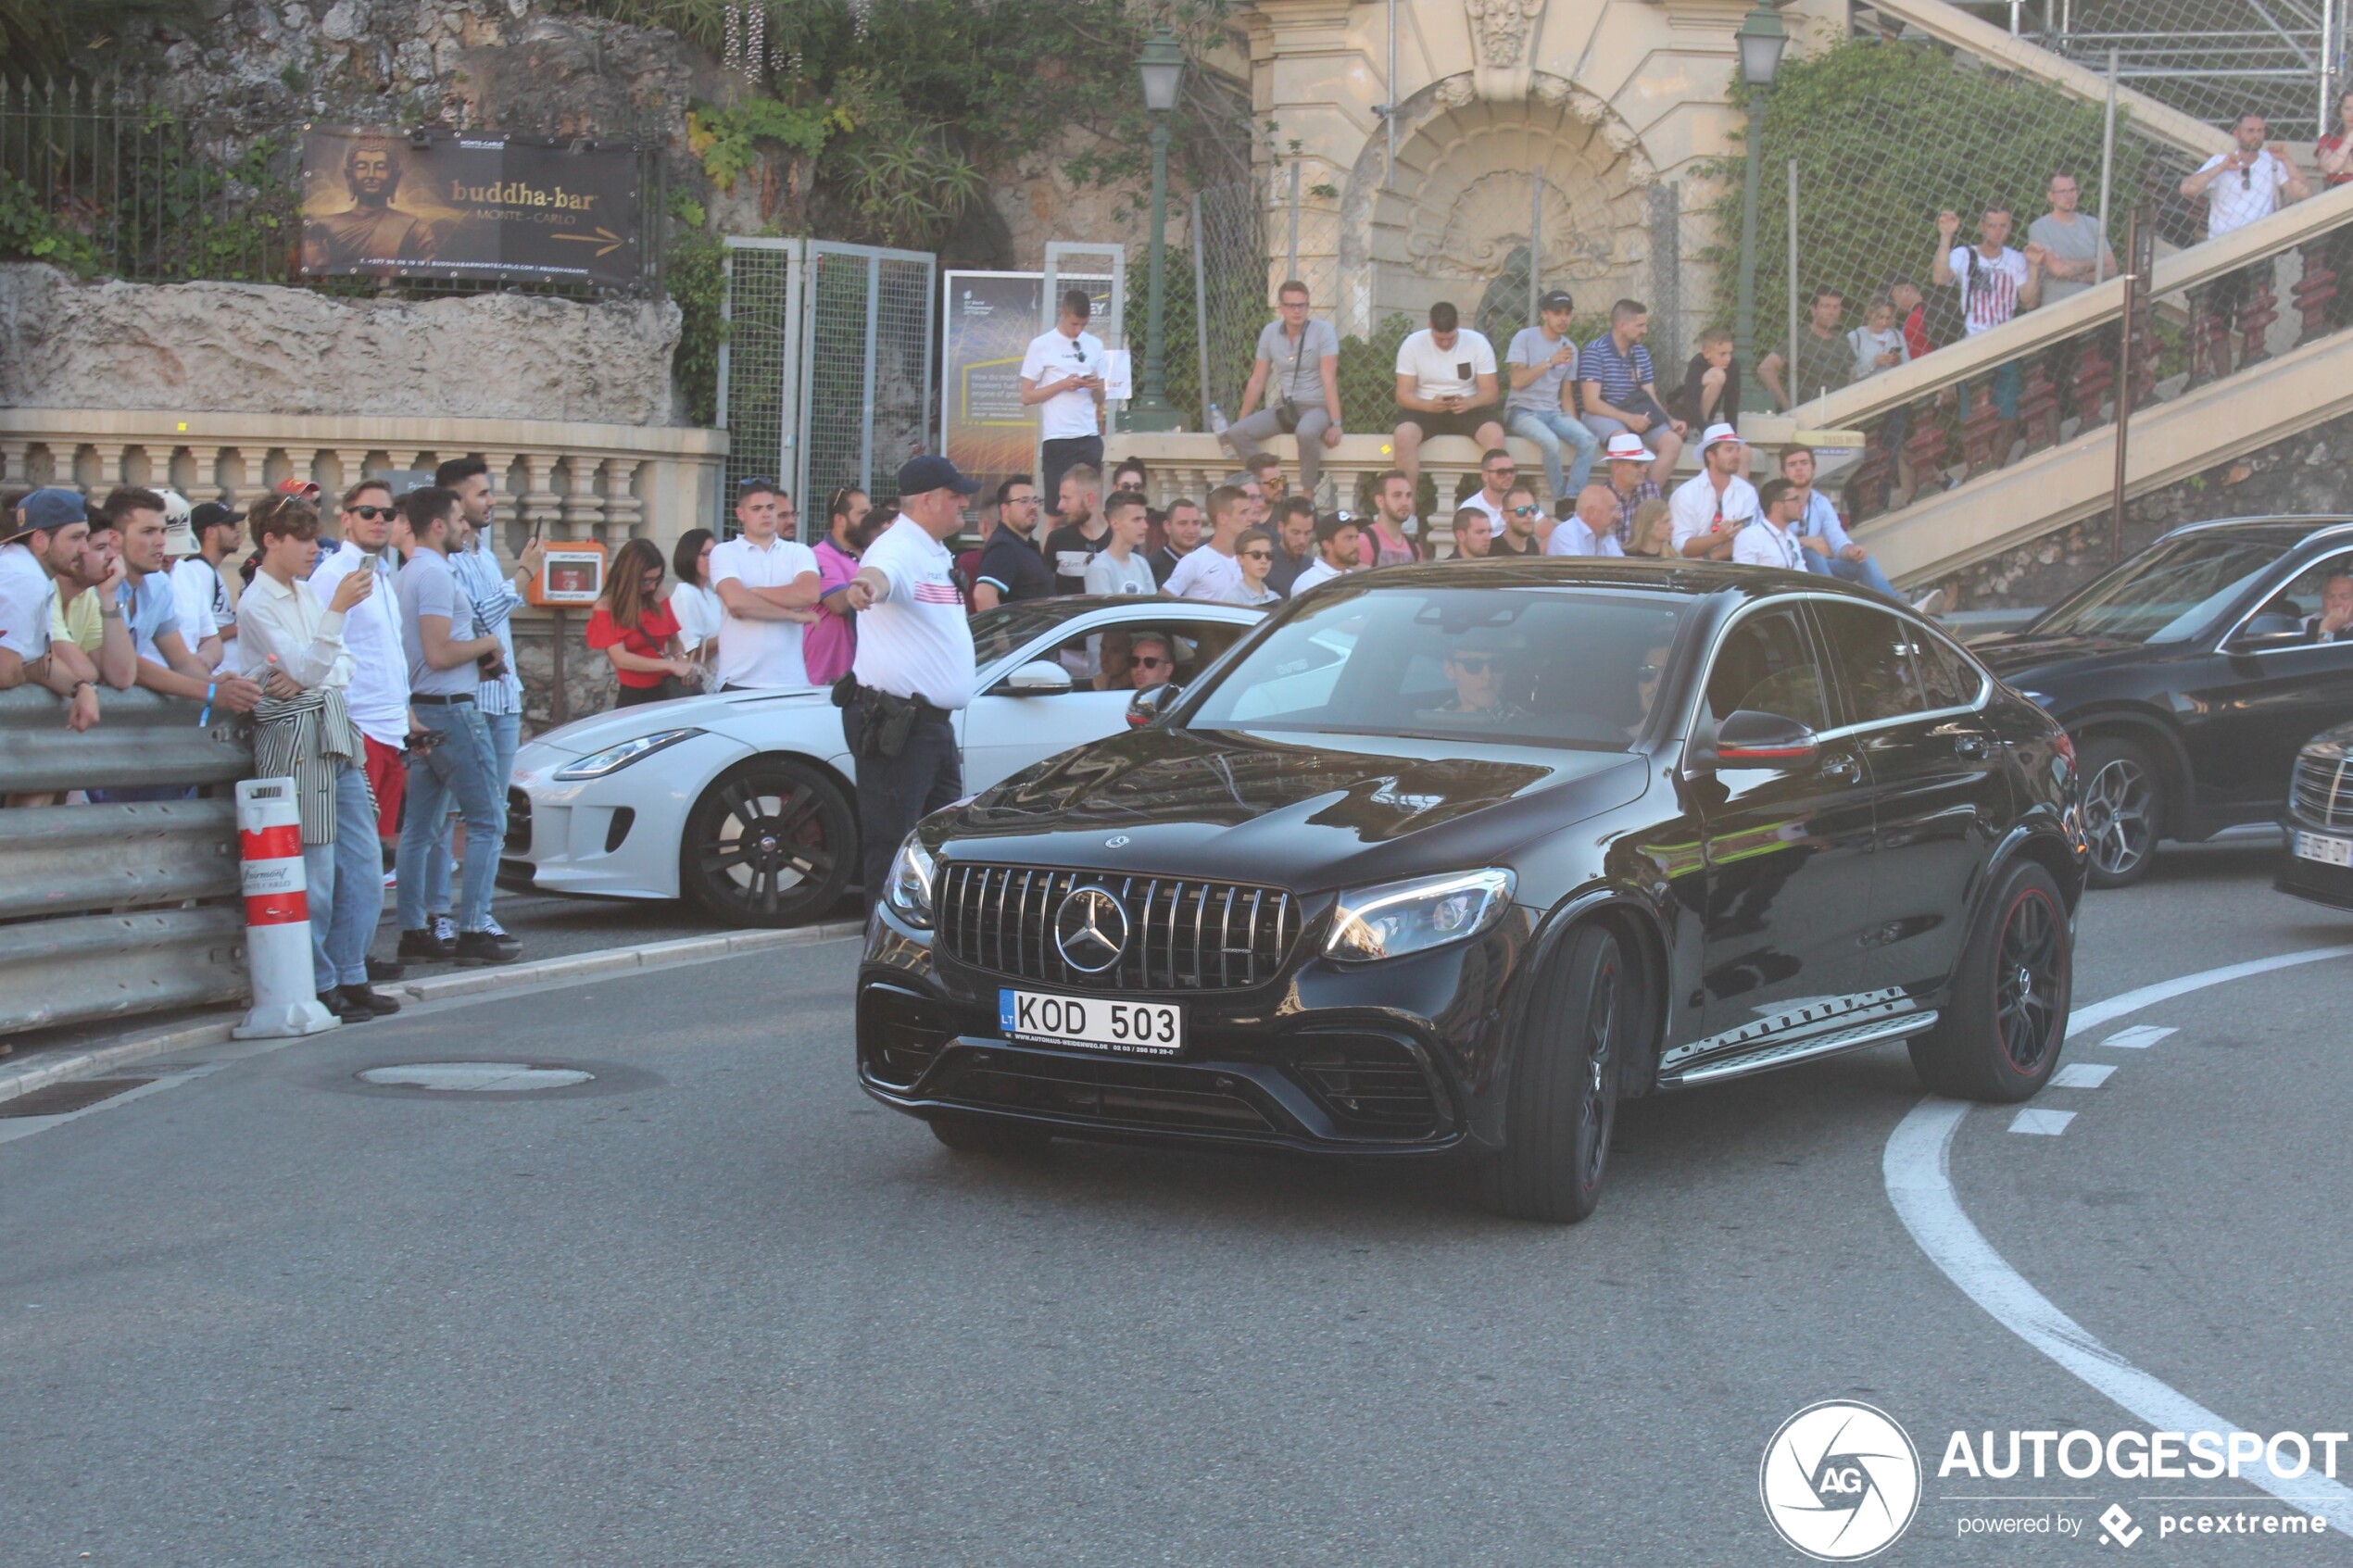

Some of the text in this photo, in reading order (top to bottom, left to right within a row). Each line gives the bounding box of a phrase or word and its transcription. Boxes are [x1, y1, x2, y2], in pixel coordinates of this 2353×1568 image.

[451, 179, 596, 211] buddha-bar
[476, 209, 524, 221] MONTE
[533, 212, 576, 225] CARLO
[1001, 1014, 1013, 1025] LT
[1018, 996, 1176, 1043] KOD 503
[1014, 1033, 1109, 1050] WWW.AUTOHAUS-WEIDENWEG.DE
